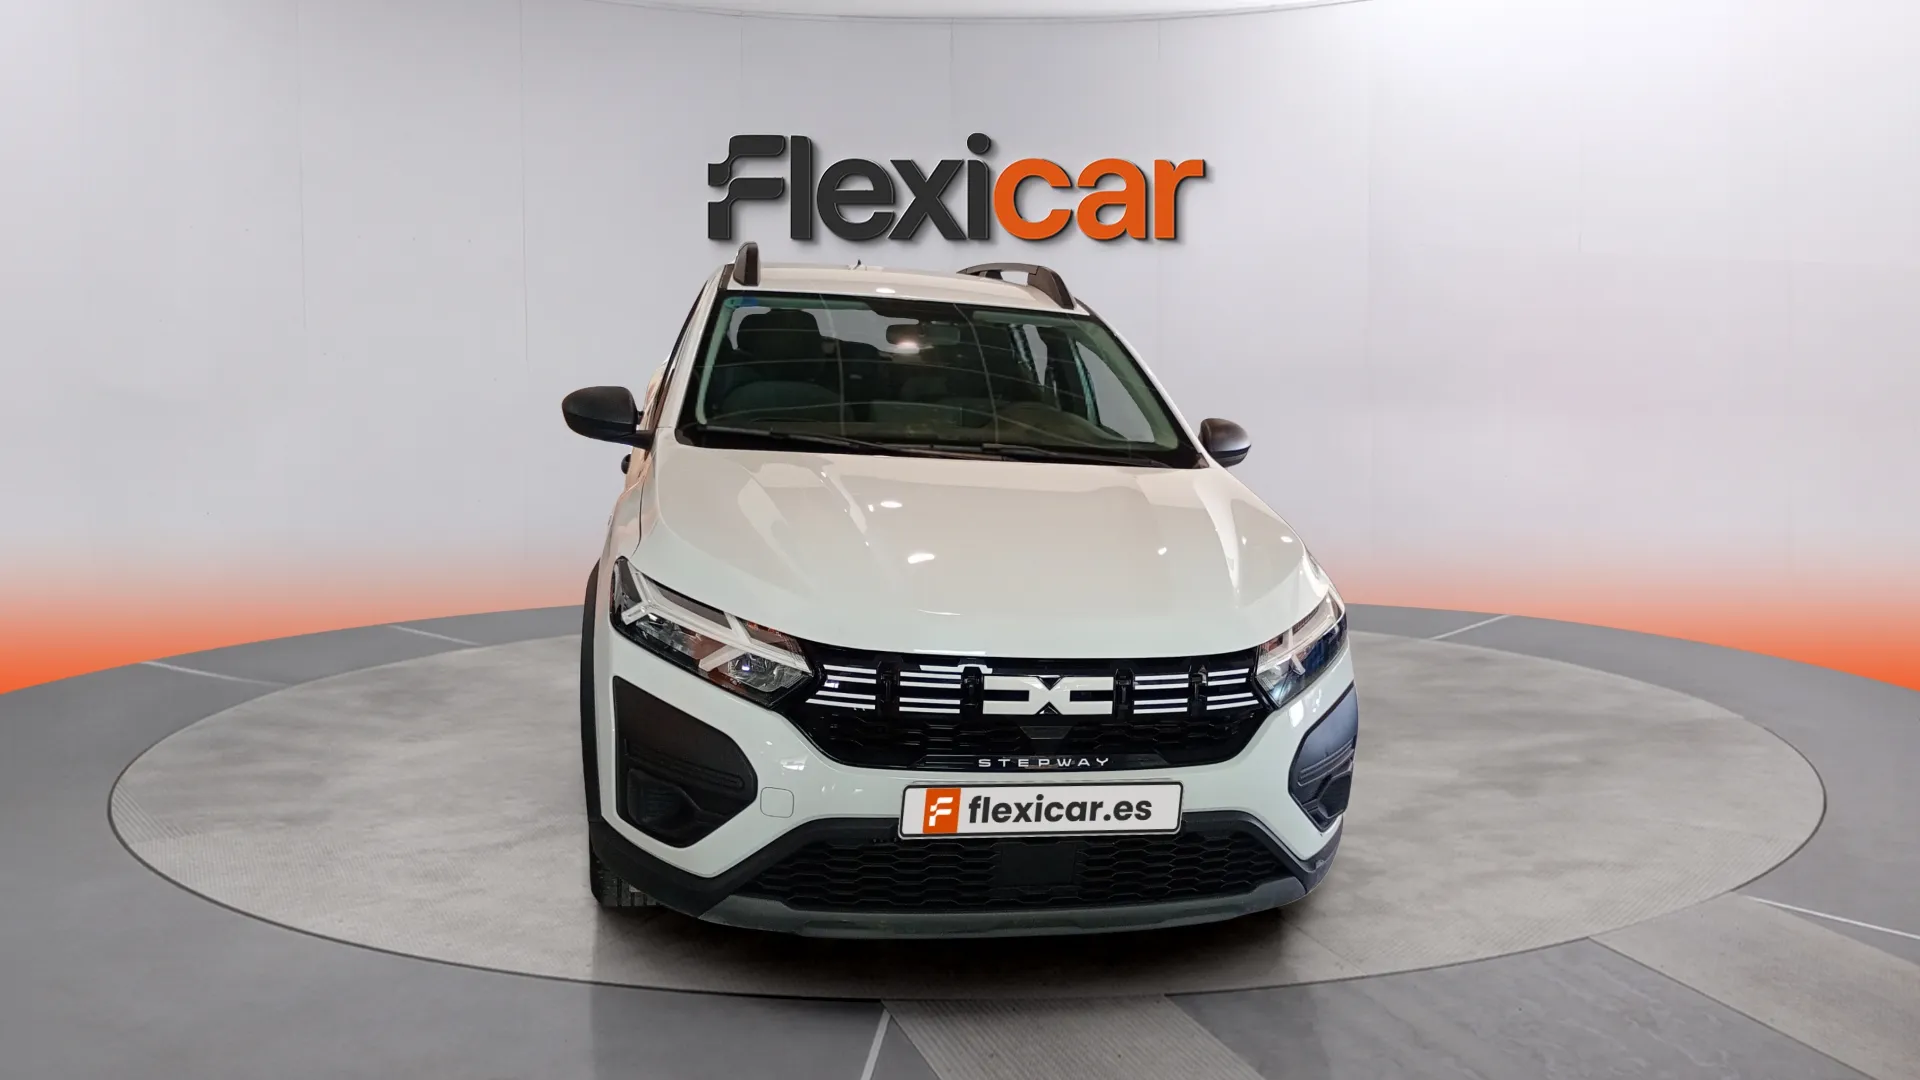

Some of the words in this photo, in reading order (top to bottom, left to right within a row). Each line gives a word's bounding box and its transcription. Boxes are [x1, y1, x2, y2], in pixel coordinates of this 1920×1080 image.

[708, 133, 1205, 240] Flexicar
[978, 757, 1110, 768] STEPWAY
[968, 793, 1153, 824] flexicar.es
